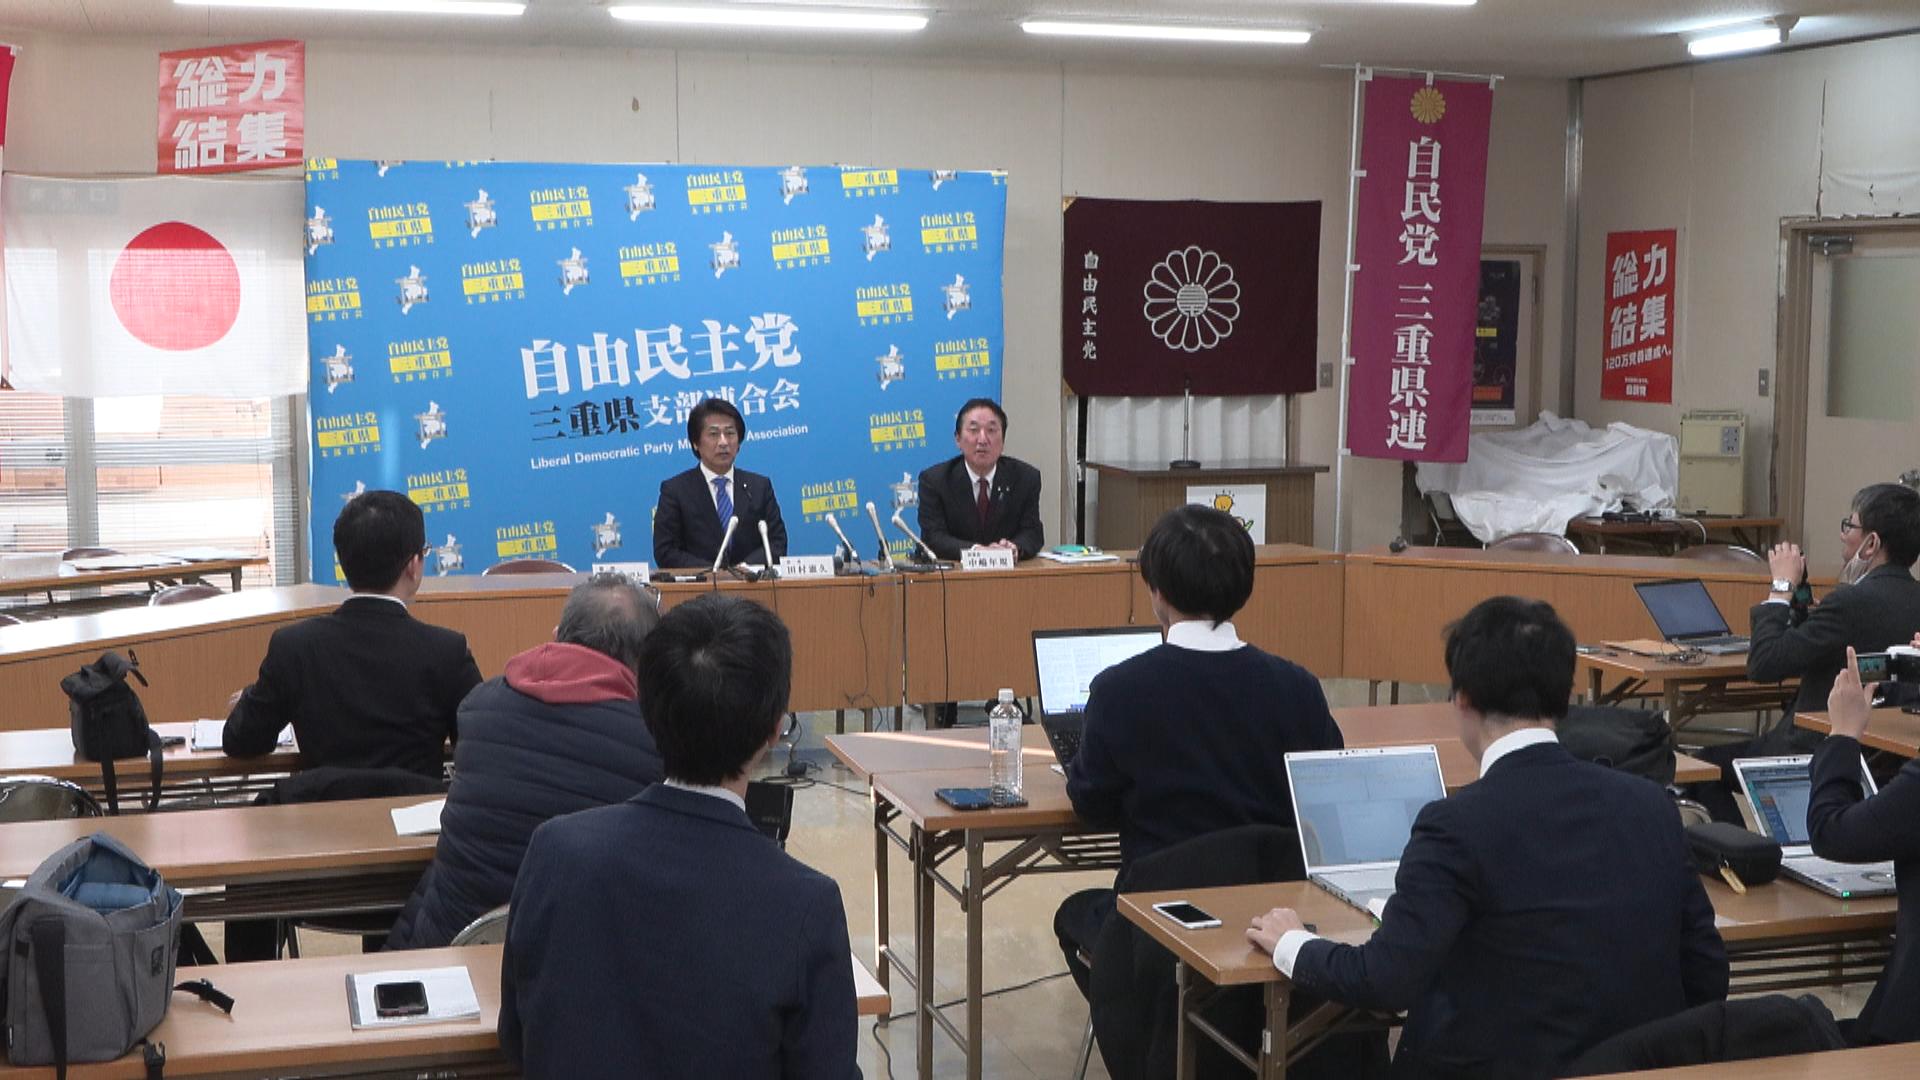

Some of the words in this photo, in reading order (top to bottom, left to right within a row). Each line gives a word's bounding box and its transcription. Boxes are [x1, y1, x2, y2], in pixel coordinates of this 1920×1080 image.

[173, 52, 287, 110] 総力
[172, 111, 288, 170] 結集
[1397, 136, 1443, 266] 自民党
[1612, 243, 1667, 299] 総力
[1081, 250, 1099, 359] 自由民主党
[1610, 294, 1667, 350] 結集
[520, 312, 802, 400] 自由民主党
[1385, 281, 1435, 452] 三重県連
[531, 453, 571, 471] Liberal
[574, 445, 641, 464] Democratic
[643, 440, 674, 457] Party
[746, 423, 809, 443] Association
